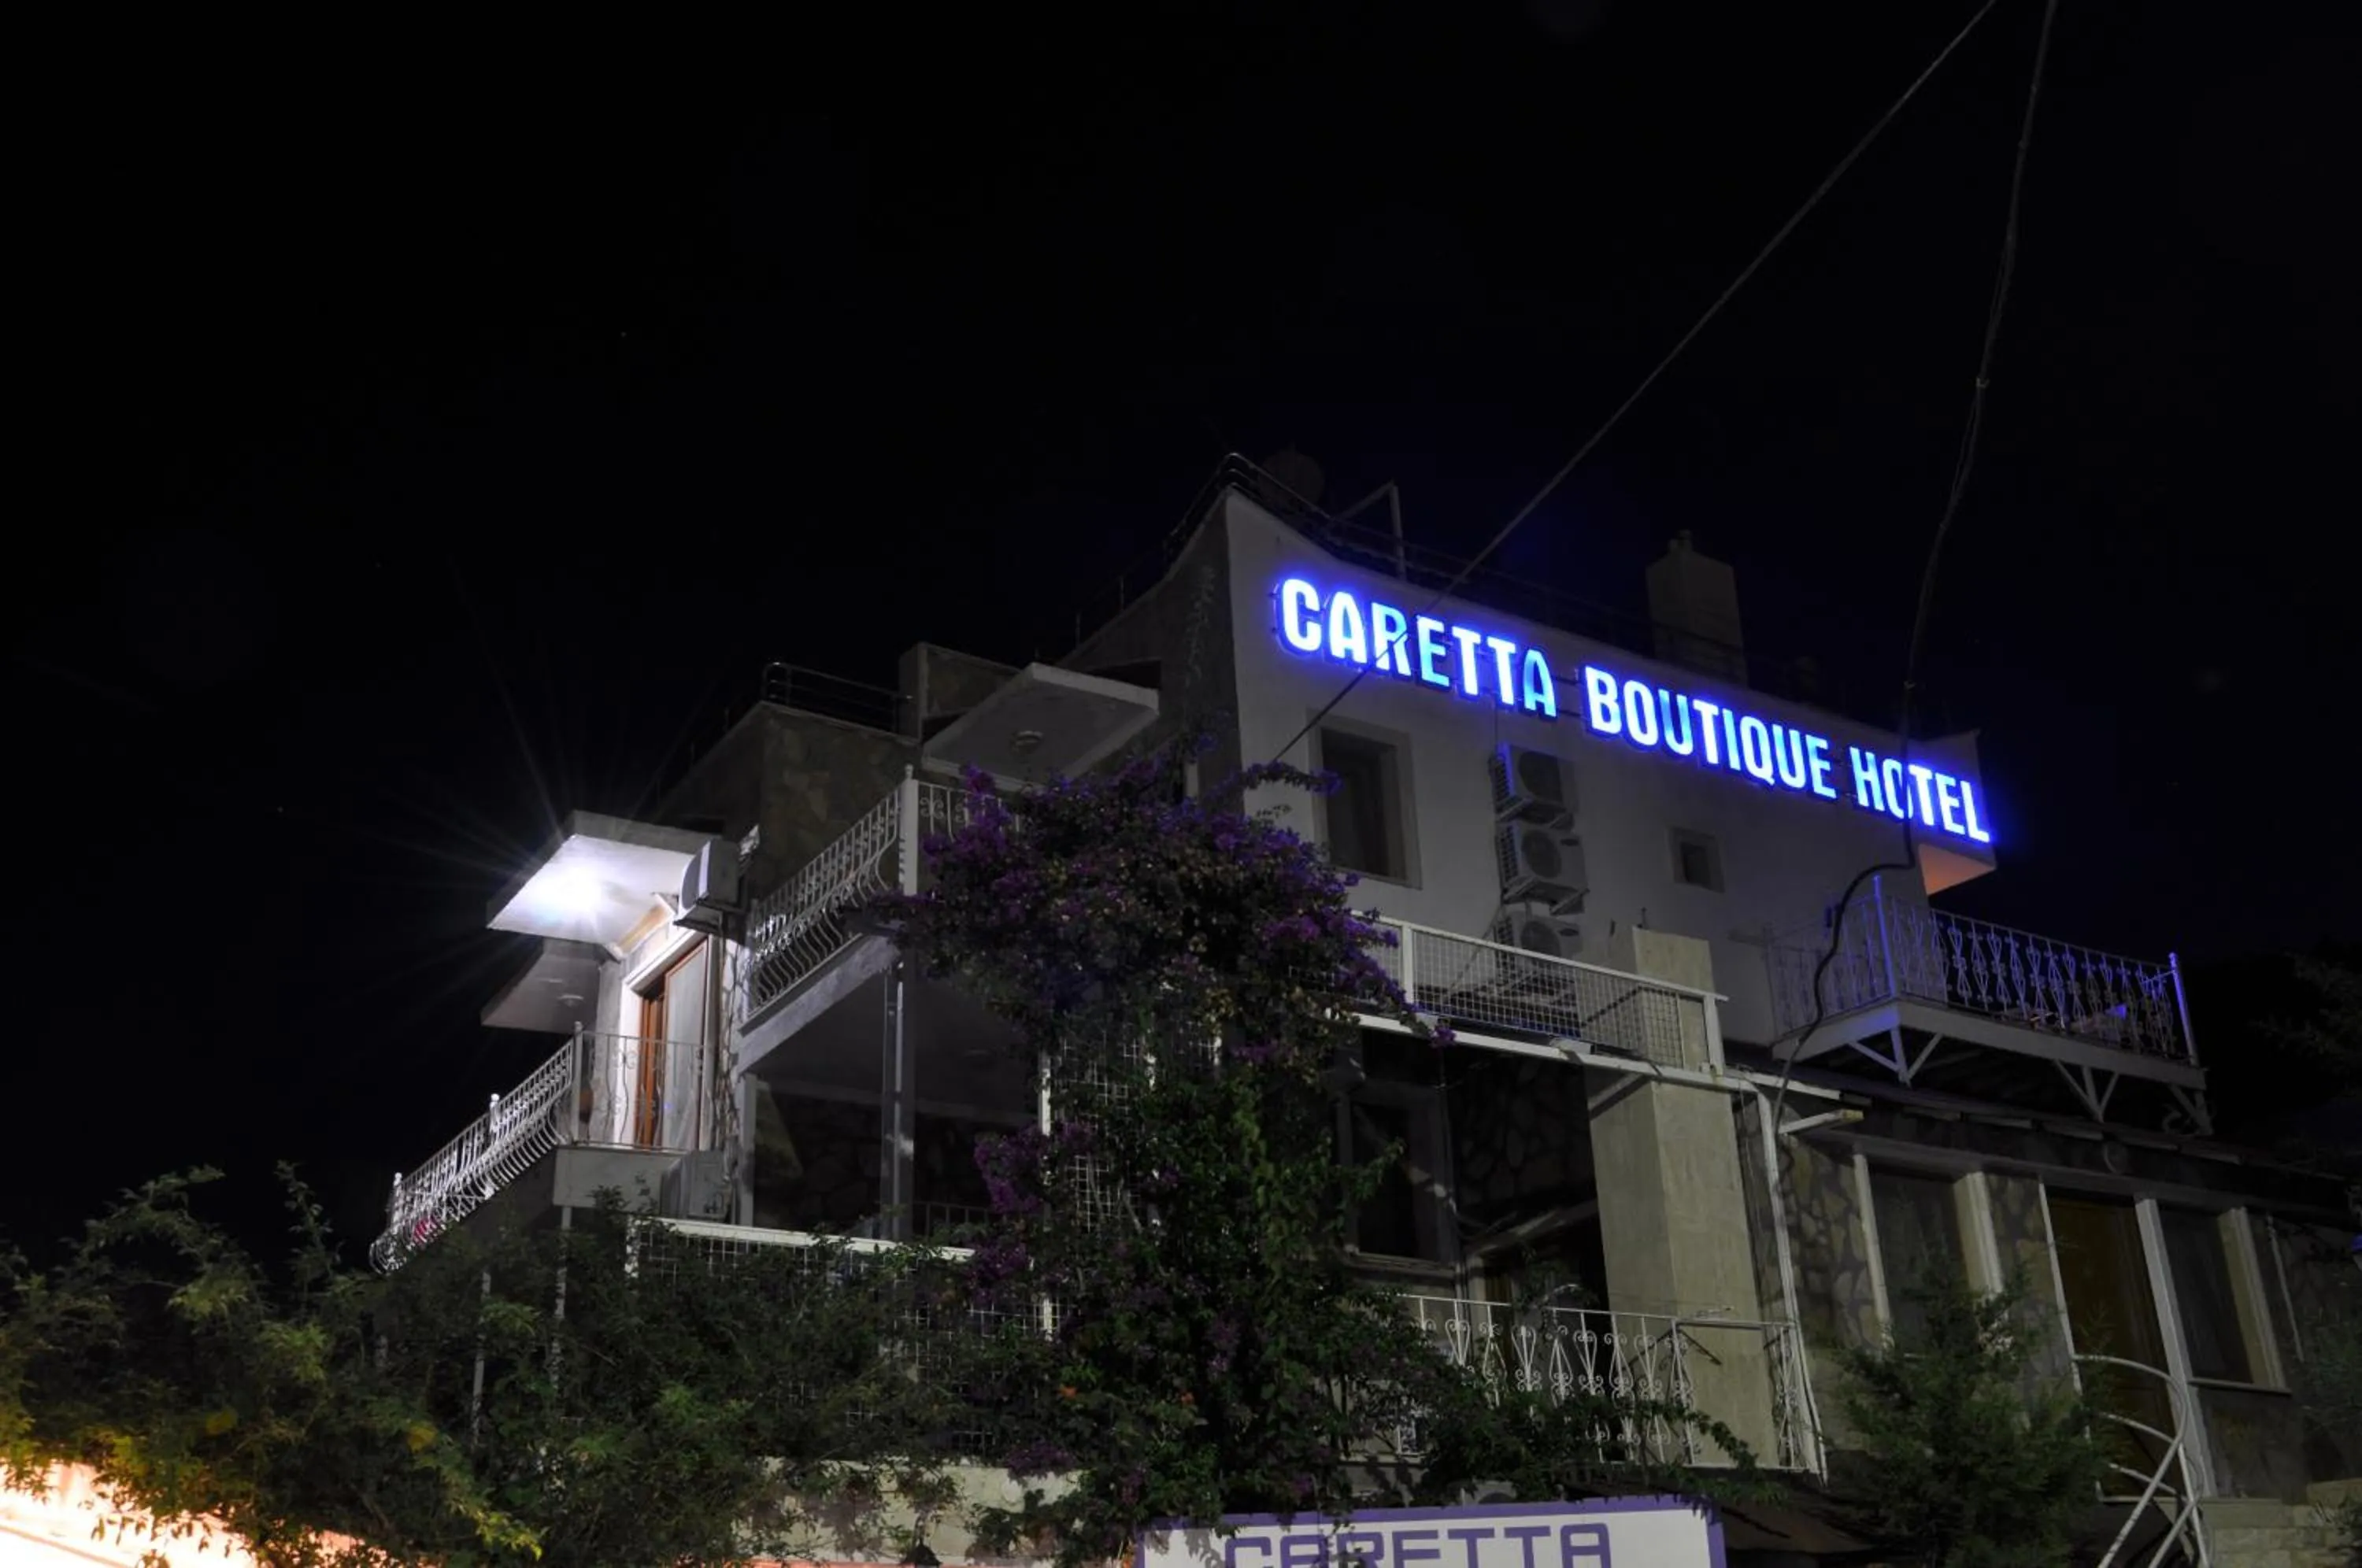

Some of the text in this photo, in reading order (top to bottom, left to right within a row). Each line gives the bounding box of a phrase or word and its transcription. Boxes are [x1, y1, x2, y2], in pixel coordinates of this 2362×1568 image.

[1281, 578, 1990, 842] CARETTA BOUTIQUE HOTEL
[1225, 1522, 1612, 1568] CARETTA
